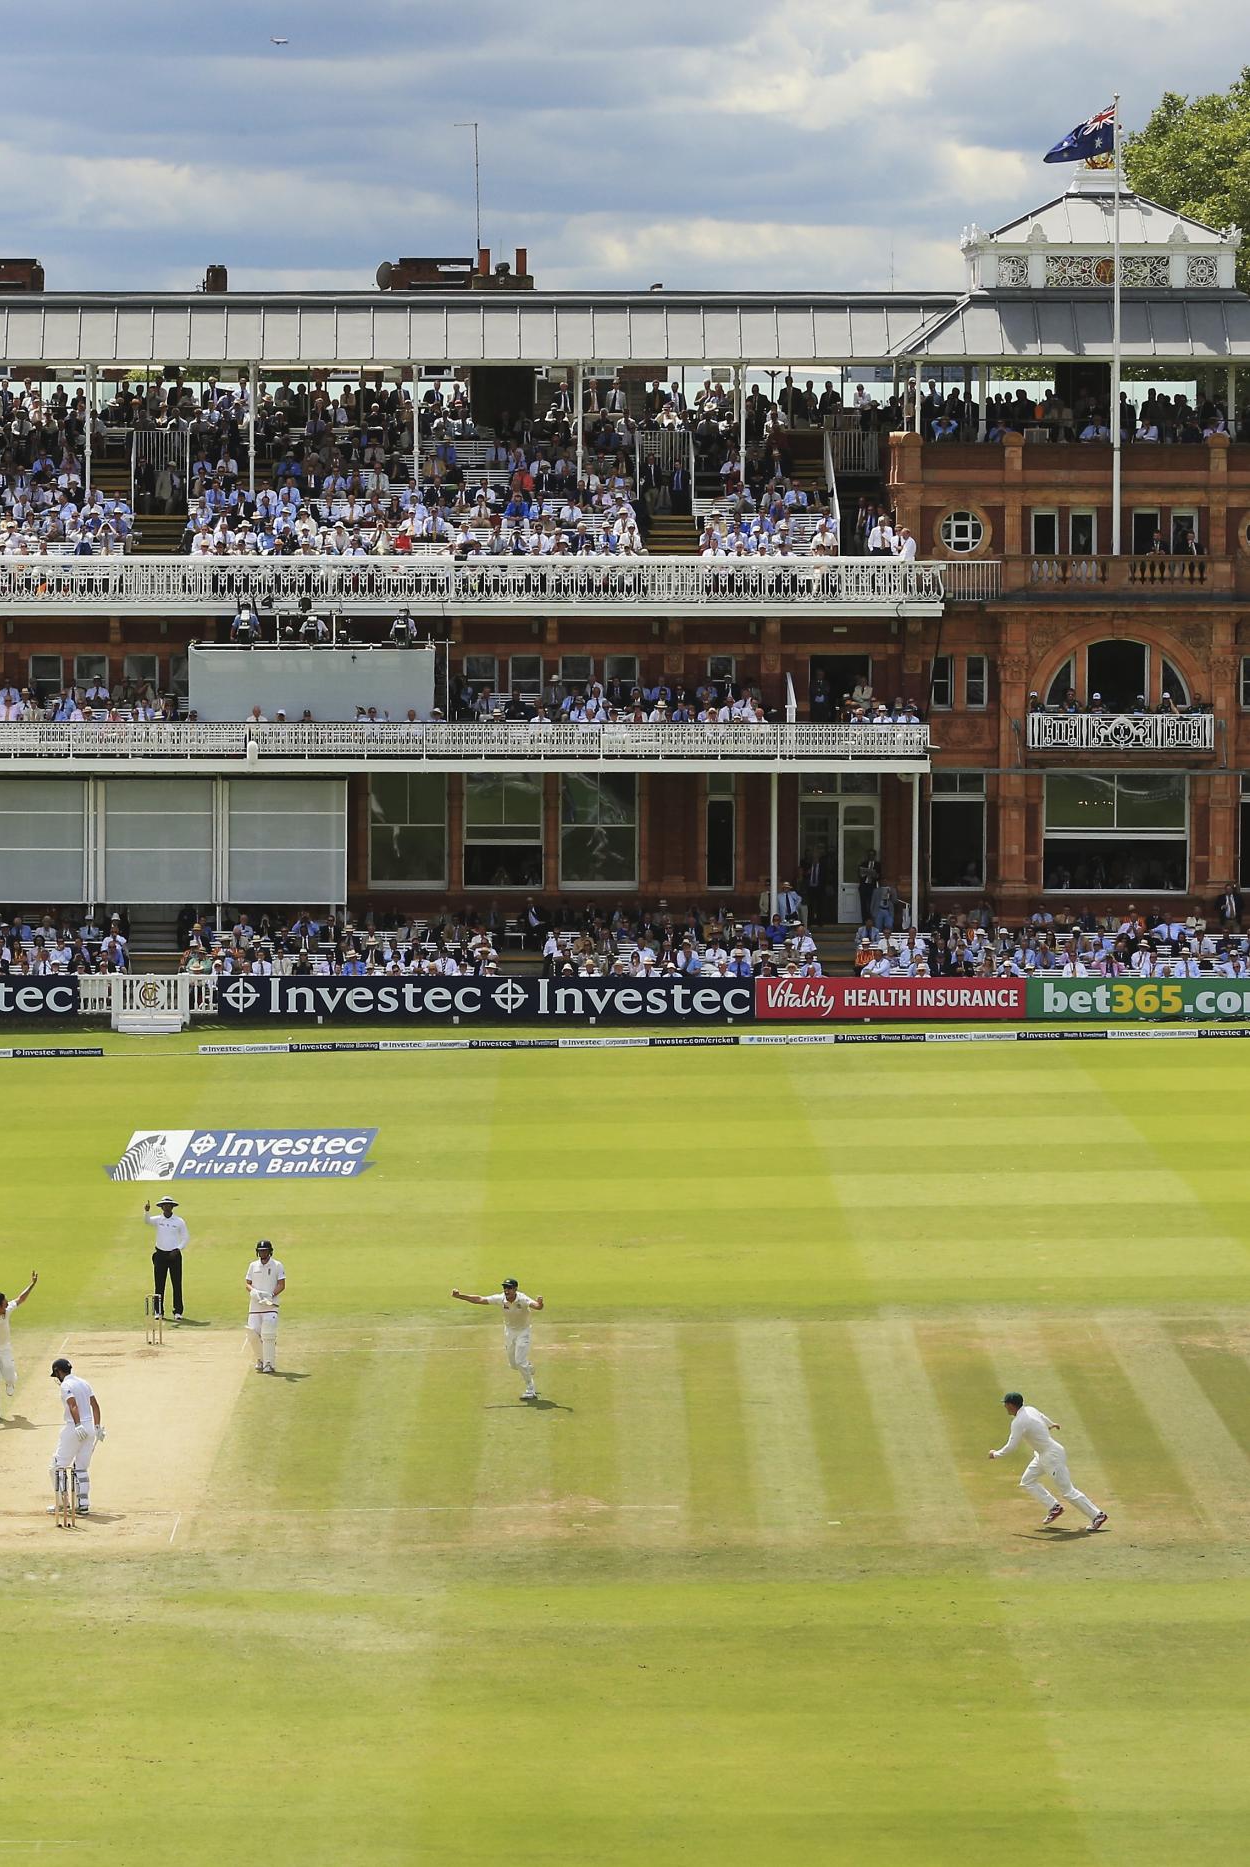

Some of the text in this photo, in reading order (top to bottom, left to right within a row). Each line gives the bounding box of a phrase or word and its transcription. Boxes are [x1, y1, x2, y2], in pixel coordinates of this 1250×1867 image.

[269, 978, 481, 1013] Investec
[538, 978, 750, 1014] Investec
[767, 979, 1019, 1016] Vitality HEALTH INSURANCE
[1043, 983, 1250, 1014] bet365.co
[902, 1034, 924, 1042] Banking
[217, 1133, 367, 1157] Investec
[180, 1157, 356, 1175] Private Banking
